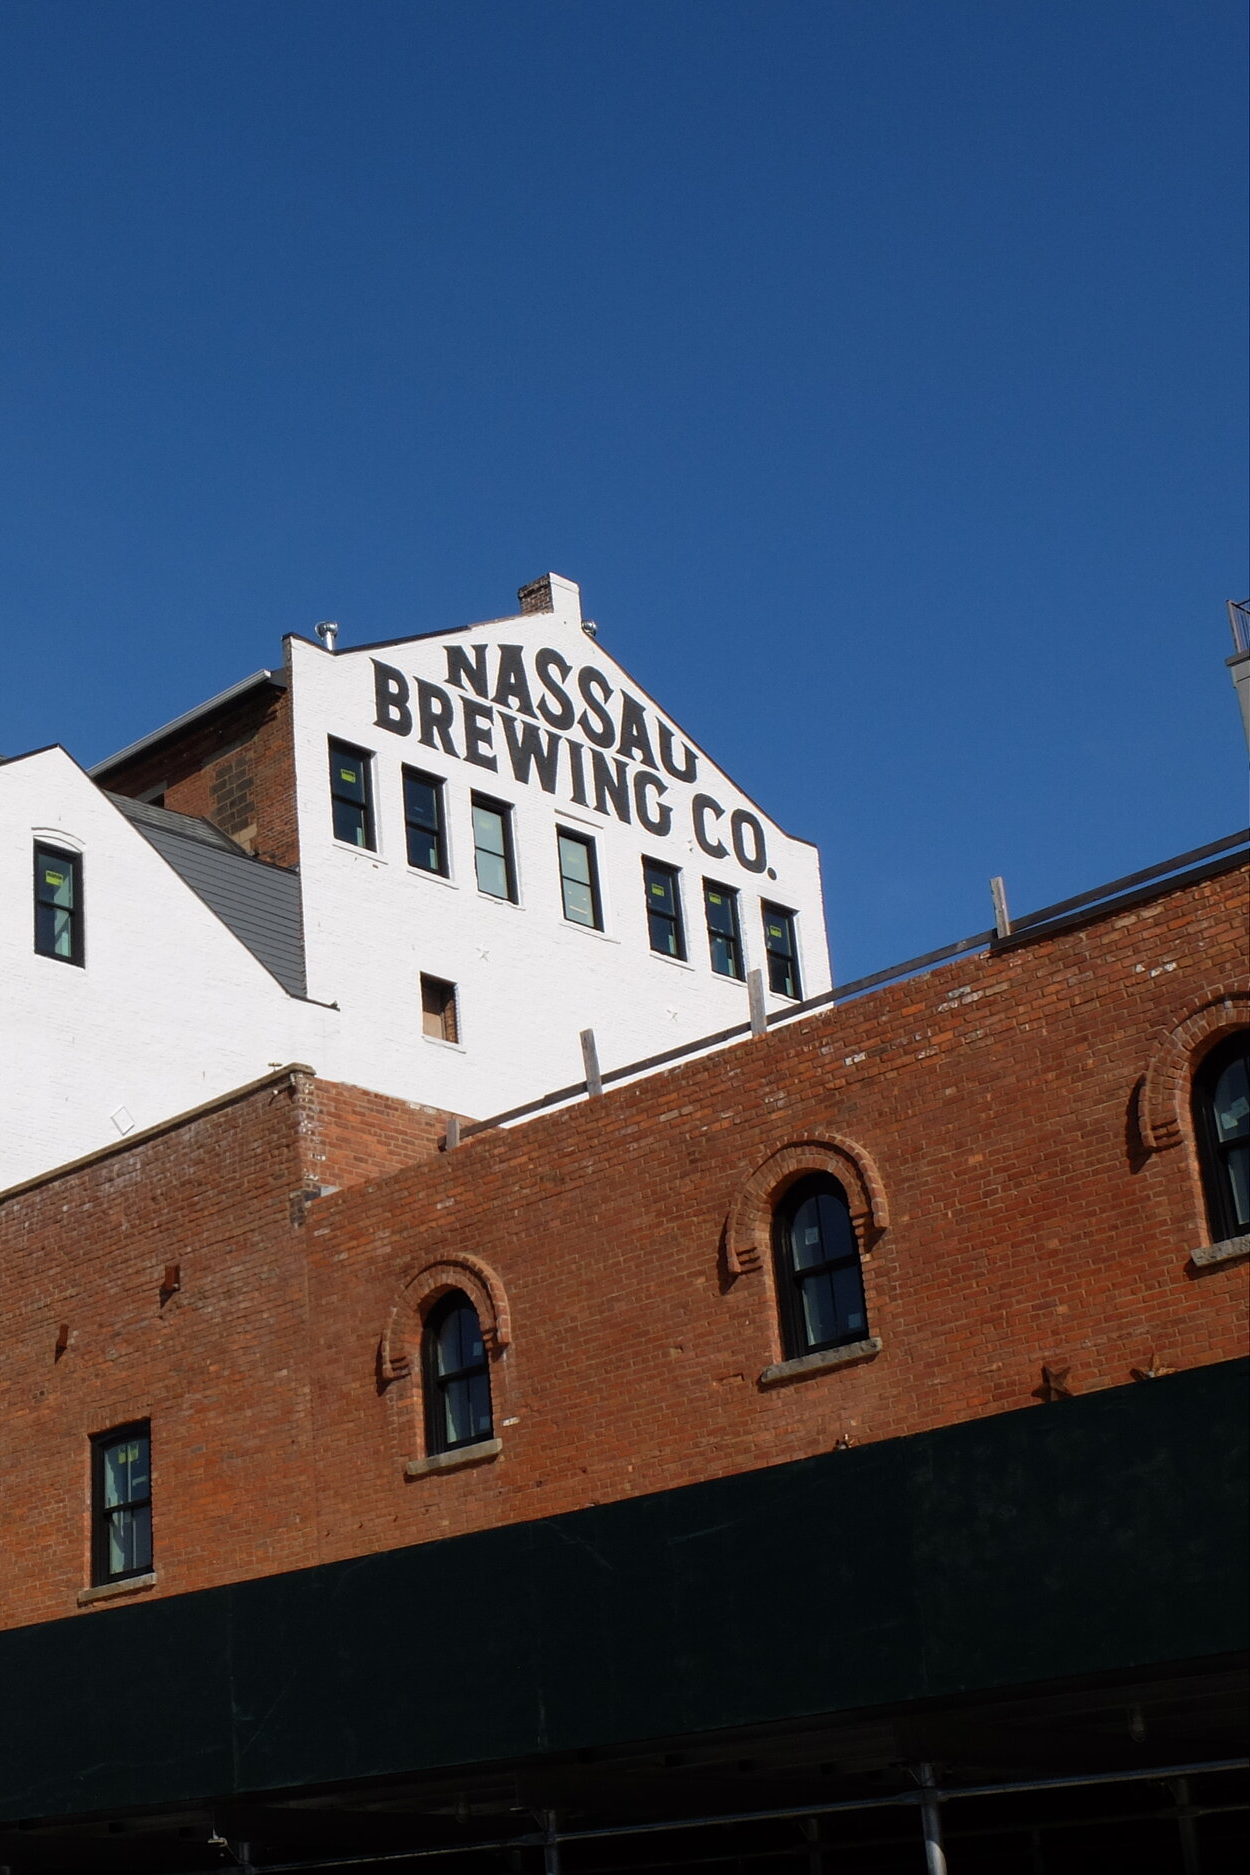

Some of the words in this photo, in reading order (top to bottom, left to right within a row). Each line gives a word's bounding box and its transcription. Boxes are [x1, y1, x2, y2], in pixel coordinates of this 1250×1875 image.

[370, 658, 674, 837] BREWING
[692, 793, 777, 881] CO.
[443, 643, 699, 784] NASSAU
